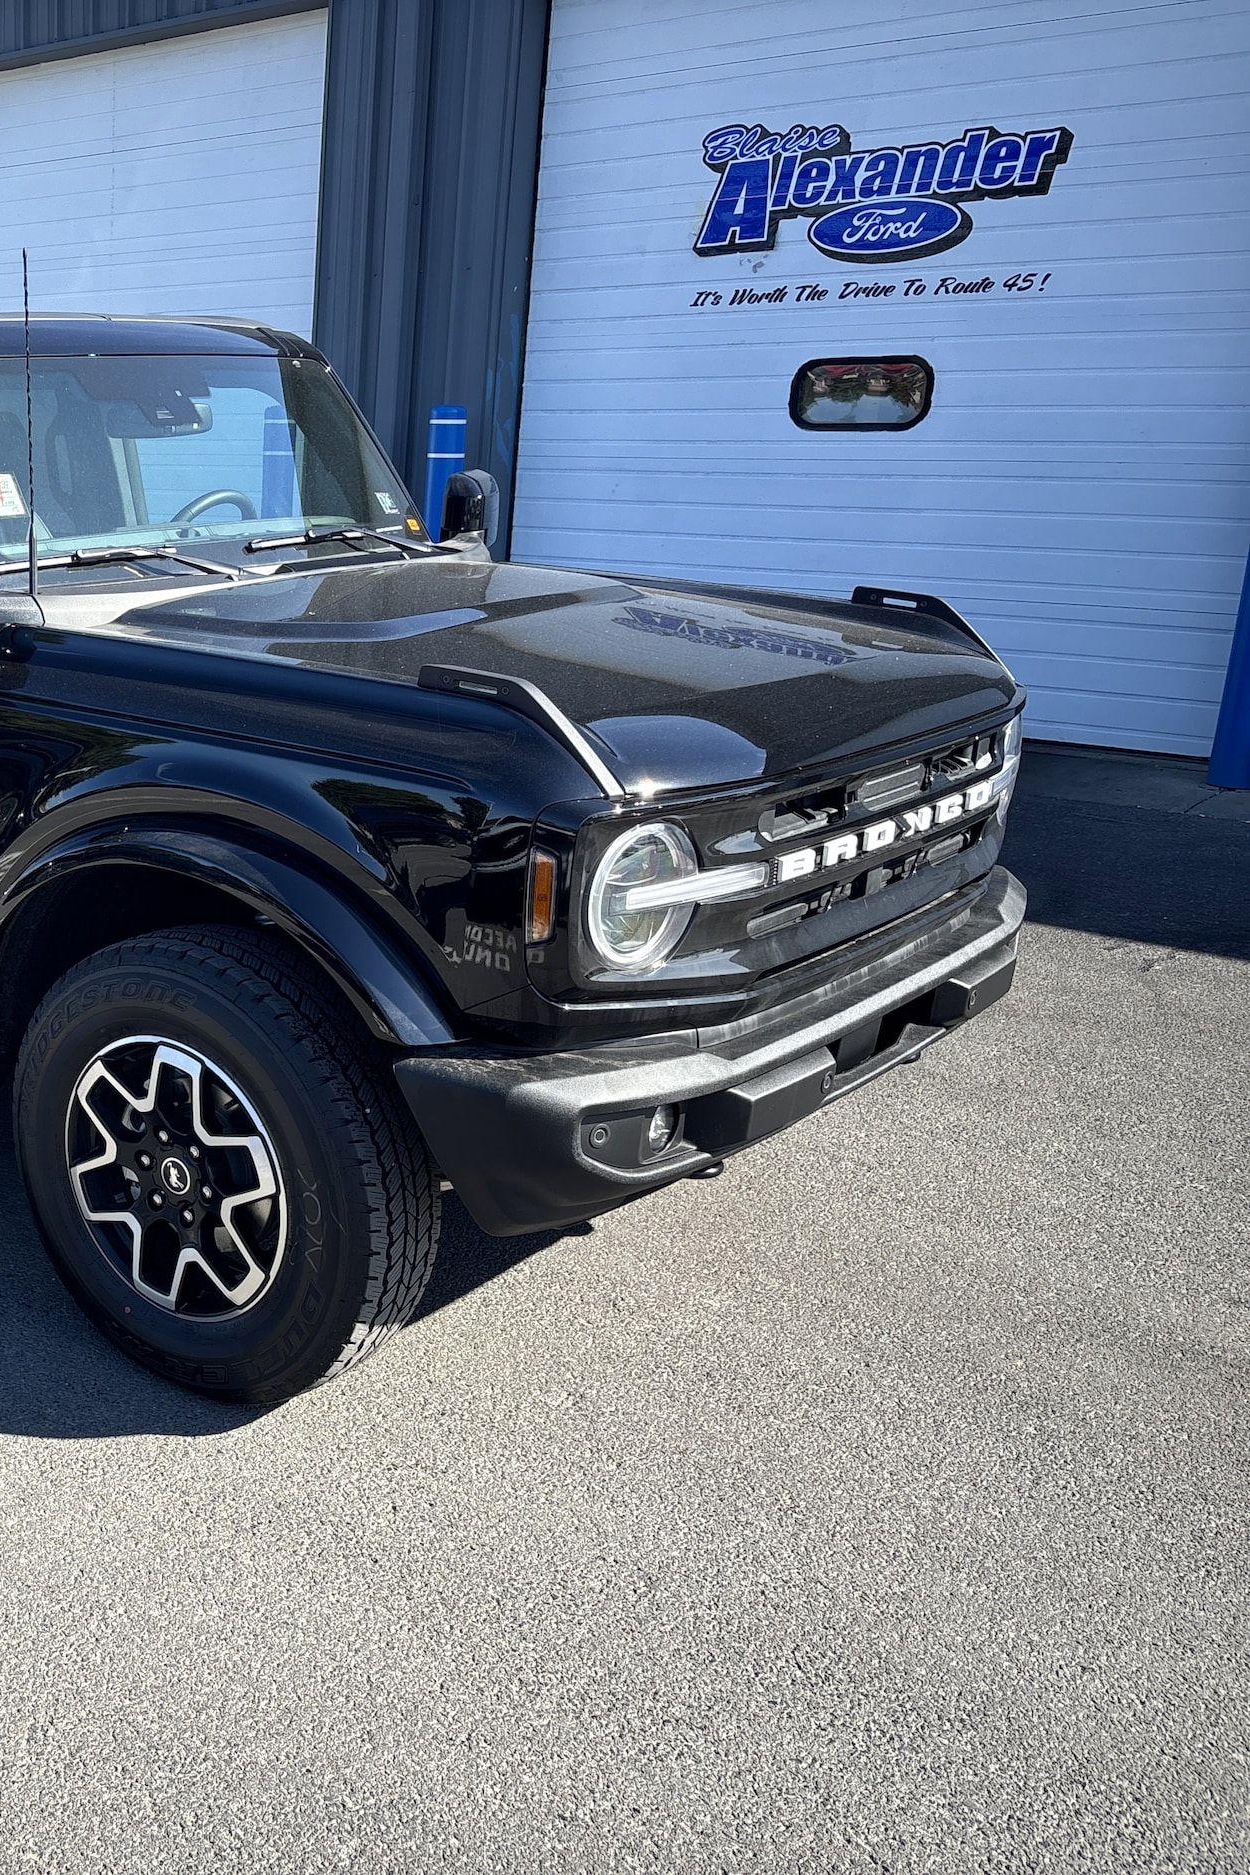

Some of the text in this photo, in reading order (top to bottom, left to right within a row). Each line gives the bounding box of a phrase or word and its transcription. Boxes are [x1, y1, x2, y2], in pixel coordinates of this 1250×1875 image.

[703, 126, 843, 165] Blaise
[695, 129, 1063, 249] Alexander
[842, 207, 928, 243] Ford
[689, 290, 723, 307] It's
[728, 285, 789, 306] Worth
[795, 283, 829, 302] The
[838, 281, 896, 299] Drive
[903, 278, 927, 297] To
[933, 276, 996, 296] Route
[777, 779, 993, 882] BRONCO
